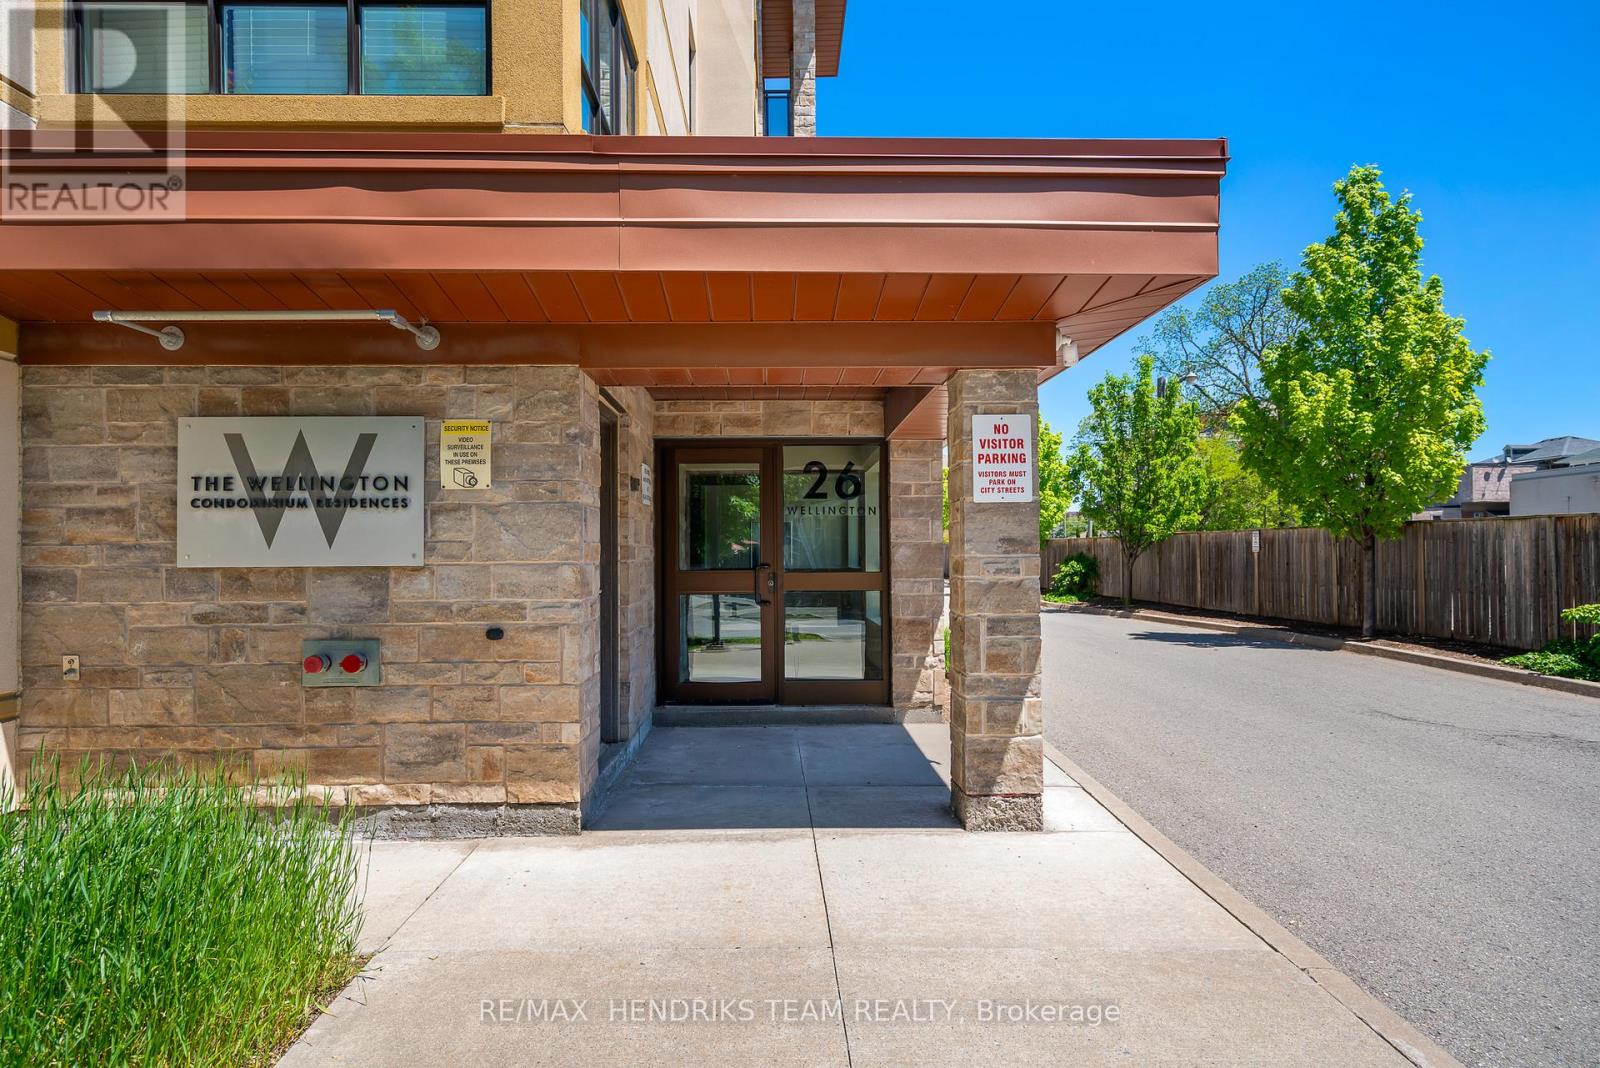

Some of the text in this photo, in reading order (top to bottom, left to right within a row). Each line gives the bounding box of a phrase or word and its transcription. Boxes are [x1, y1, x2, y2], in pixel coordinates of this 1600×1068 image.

[993, 423, 1009, 435] NO
[979, 438, 1024, 449] VISITOR
[977, 453, 1027, 464] PARKING
[190, 475, 409, 492] THE WELLINGTON
[803, 460, 861, 500] 26
[223, 428, 378, 550] W
[190, 497, 409, 509] CONDOMINIUM RESIDENCES
[787, 506, 877, 515] WELLINGTON
